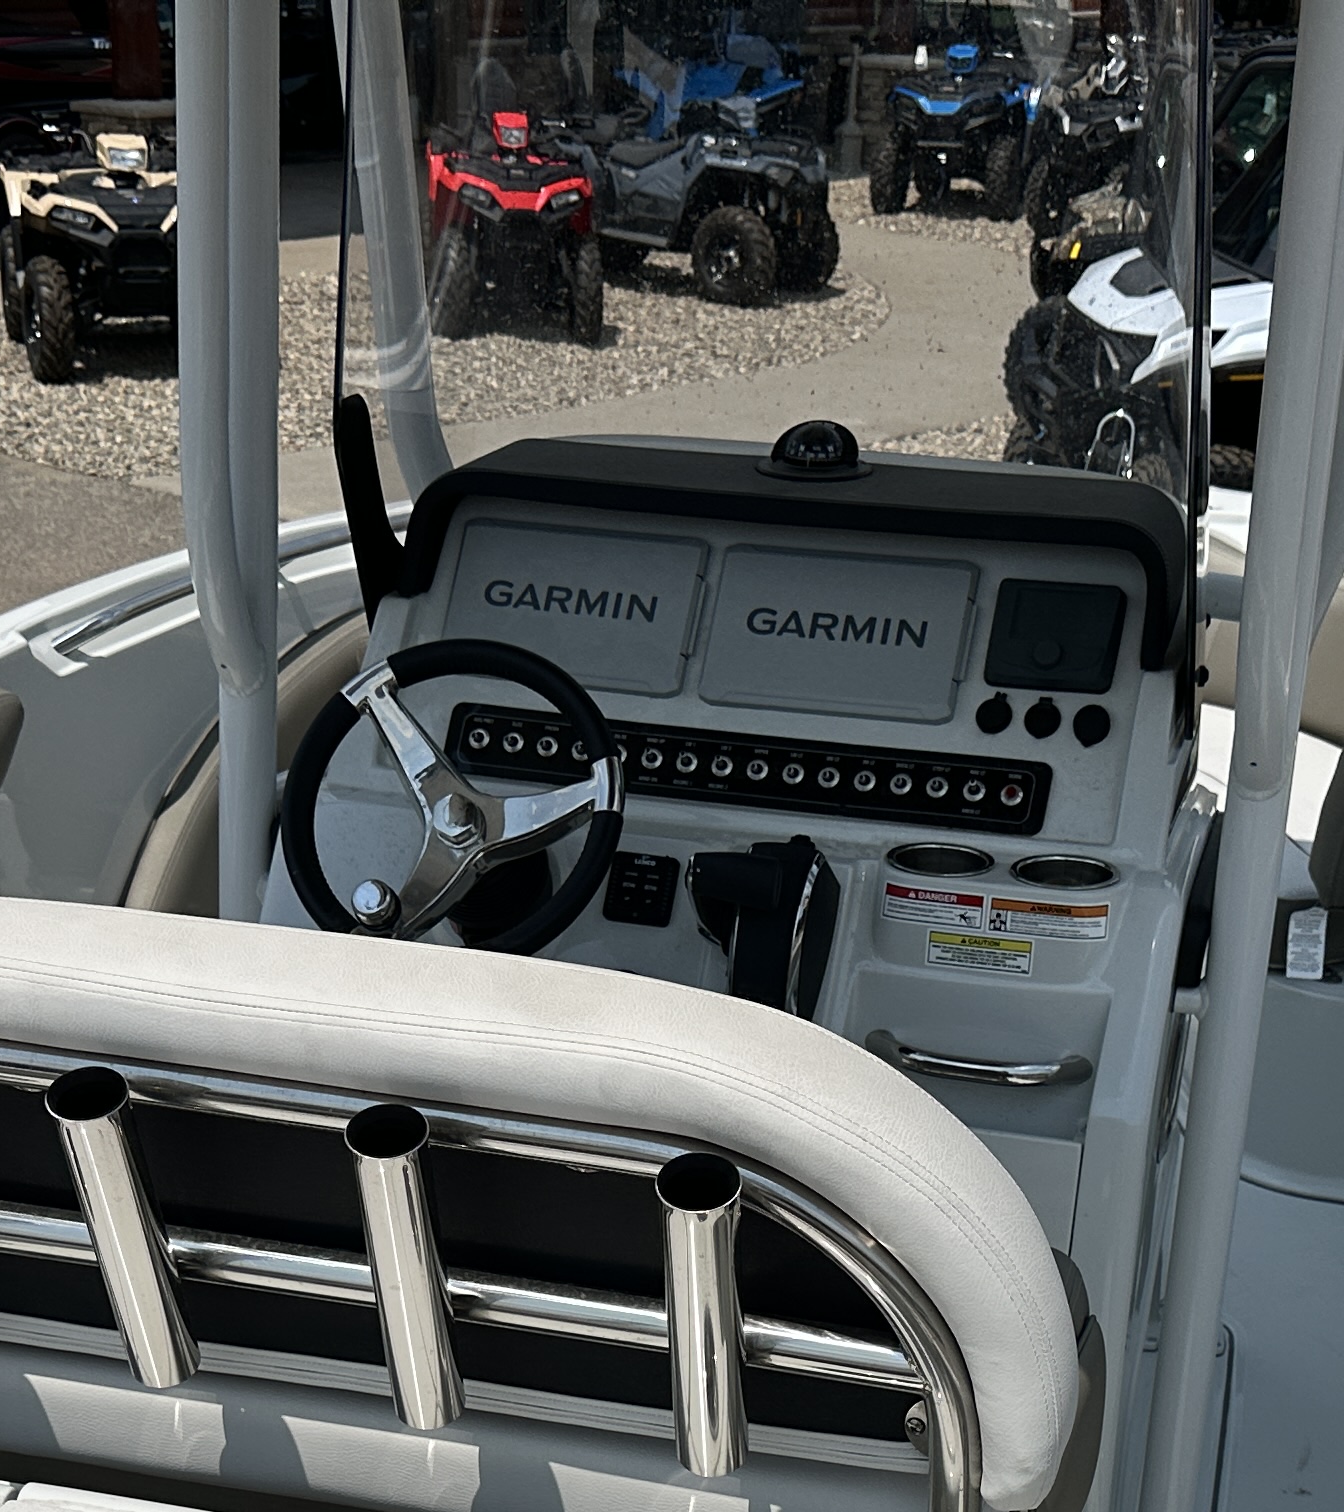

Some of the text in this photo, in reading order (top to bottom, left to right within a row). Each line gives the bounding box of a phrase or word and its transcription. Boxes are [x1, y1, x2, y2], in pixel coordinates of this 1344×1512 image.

[484, 580, 658, 623] GARMIN
[746, 607, 928, 648] GARMIN
[917, 891, 958, 903] DANGER
[1036, 905, 1072, 915] WARNING
[968, 938, 1001, 947] CAUTION
